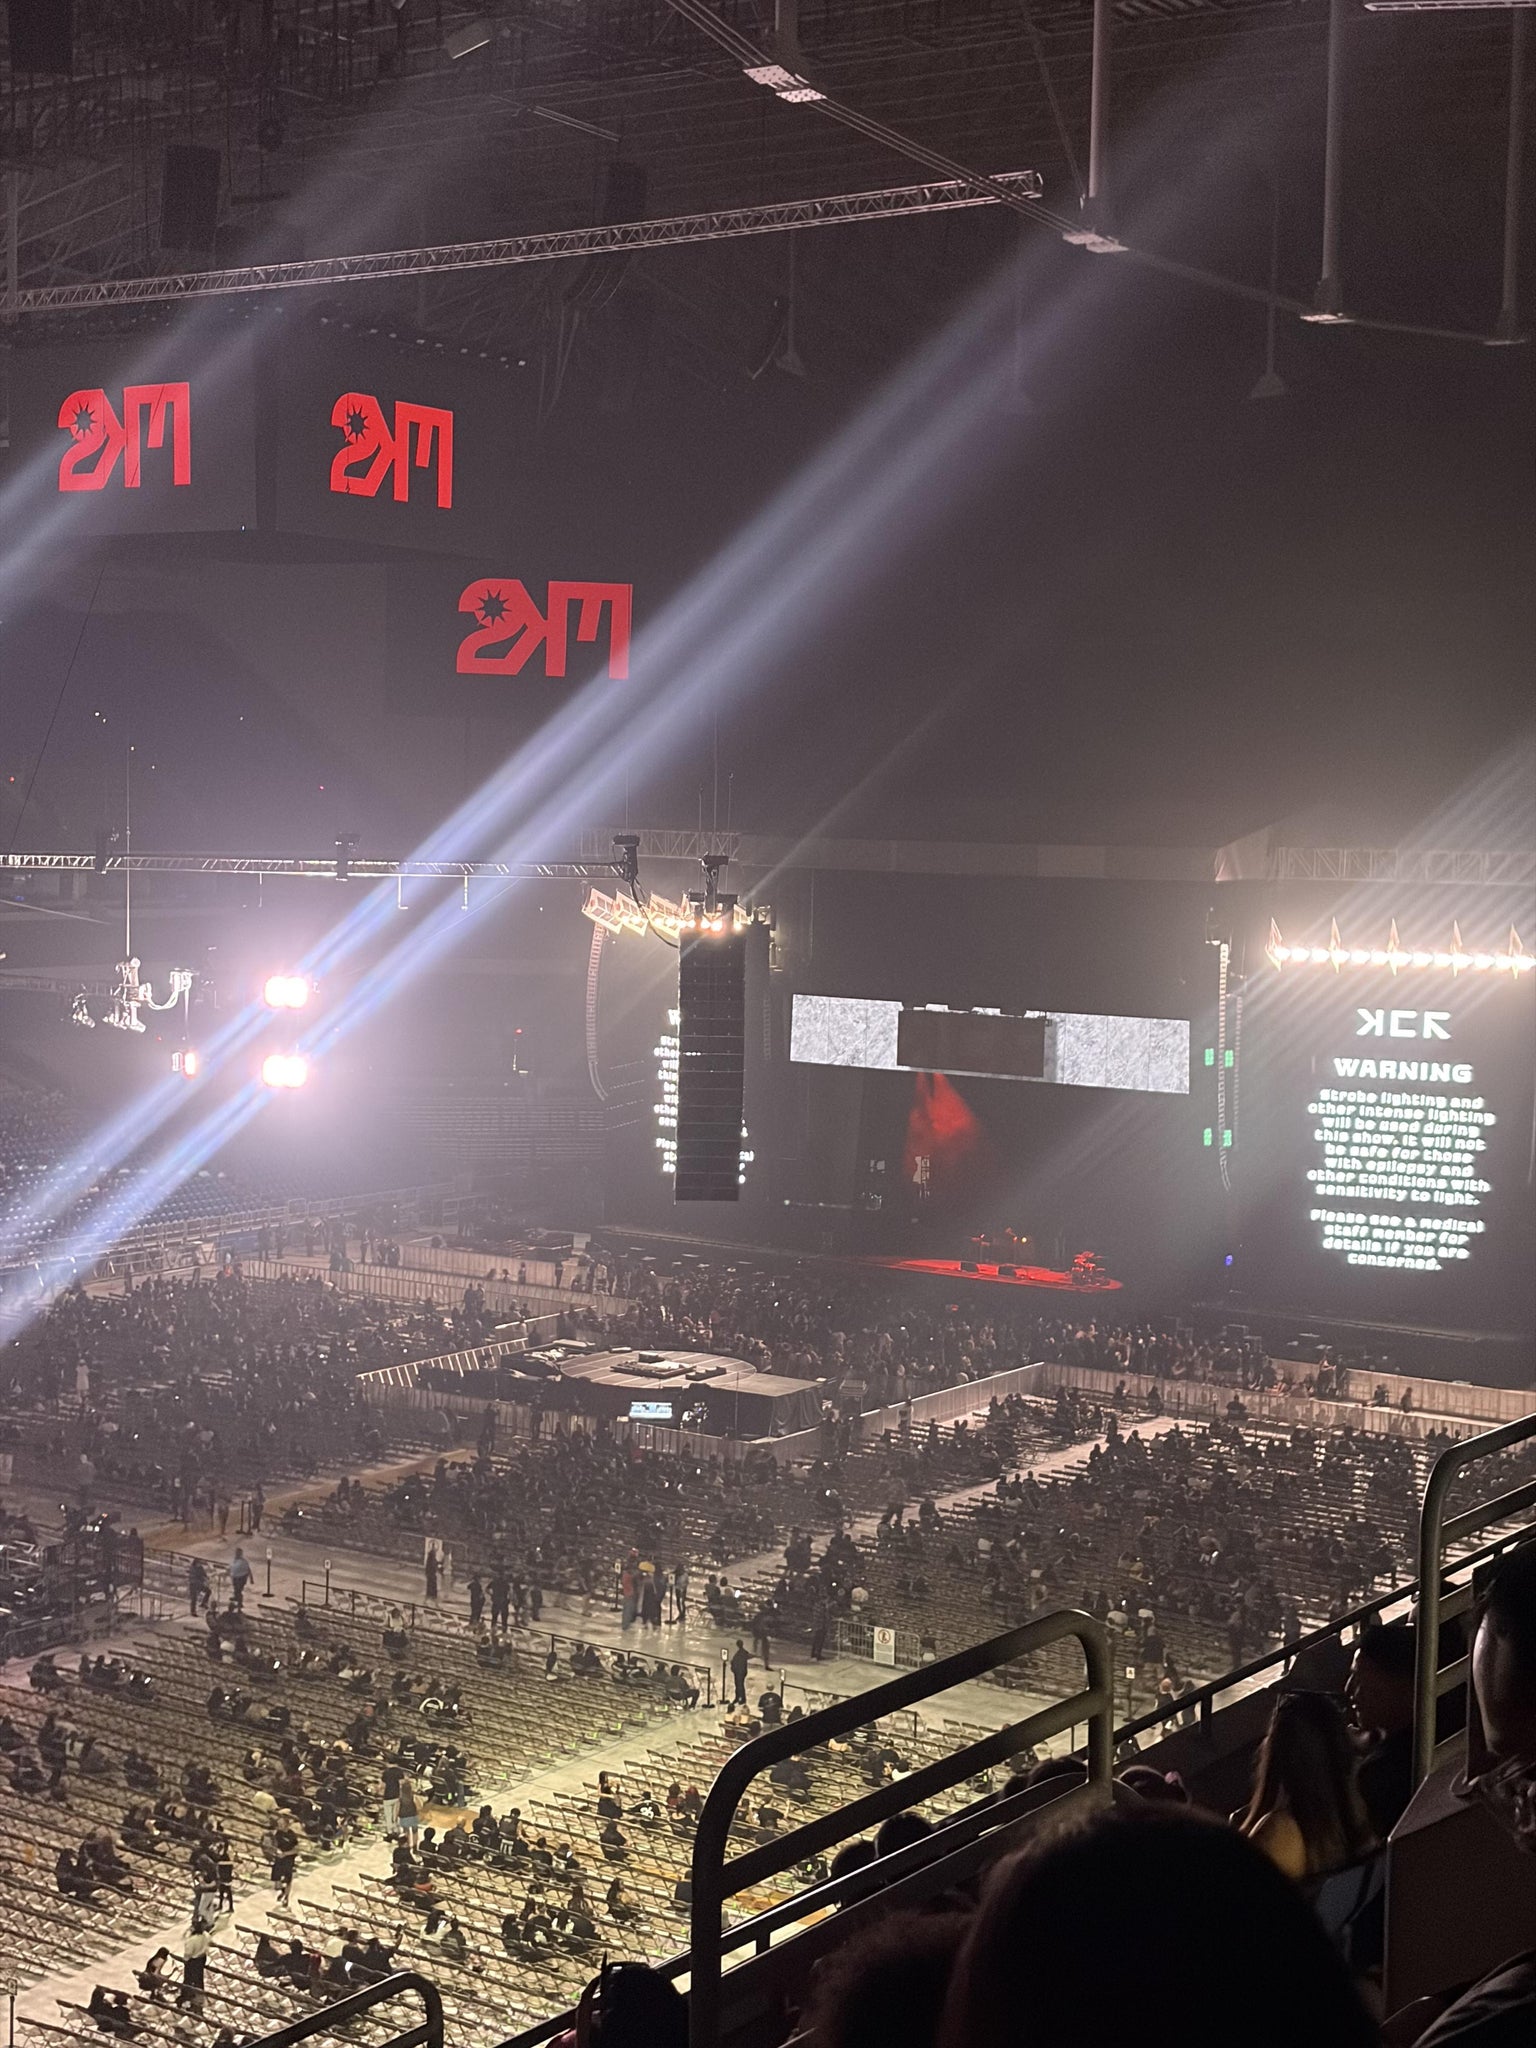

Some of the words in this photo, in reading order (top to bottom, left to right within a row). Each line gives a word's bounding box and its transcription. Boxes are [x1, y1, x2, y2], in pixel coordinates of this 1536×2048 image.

[1333, 1057, 1473, 1083] WARNING
[1320, 1089, 1378, 1104] Strobe
[1380, 1092, 1447, 1108] lighting
[1450, 1096, 1484, 1109] and
[1308, 1103, 1357, 1115] other
[1359, 1105, 1425, 1120] intense
[1427, 1109, 1496, 1126] lighting
[1322, 1117, 1351, 1129] will
[1355, 1118, 1376, 1130] be
[1379, 1121, 1421, 1133] used
[1423, 1122, 1480, 1138] during
[1314, 1129, 1349, 1142] this
[1421, 1135, 1452, 1149] will
[1455, 1138, 1487, 1151] not
[1325, 1143, 1347, 1155] be
[1350, 1146, 1389, 1158] safe
[1392, 1147, 1420, 1160] for
[1423, 1149, 1474, 1163] those
[1324, 1157, 1362, 1170] with
[1366, 1160, 1437, 1176] epilepsy
[1440, 1165, 1474, 1177] and
[1307, 1169, 1356, 1182] other
[1359, 1173, 1448, 1189] conditions
[1451, 1179, 1491, 1192] with
[1316, 1183, 1408, 1202] sensitivity
[1411, 1190, 1431, 1202] to
[1310, 1208, 1366, 1223] Please
[1370, 1214, 1402, 1227] see
[1324, 1224, 1369, 1237] staff
[1439, 1232, 1470, 1245] for
[1323, 1237, 1382, 1252] details
[1385, 1241, 1400, 1253] if
[1404, 1243, 1435, 1256] you
[1438, 1247, 1470, 1259] are
